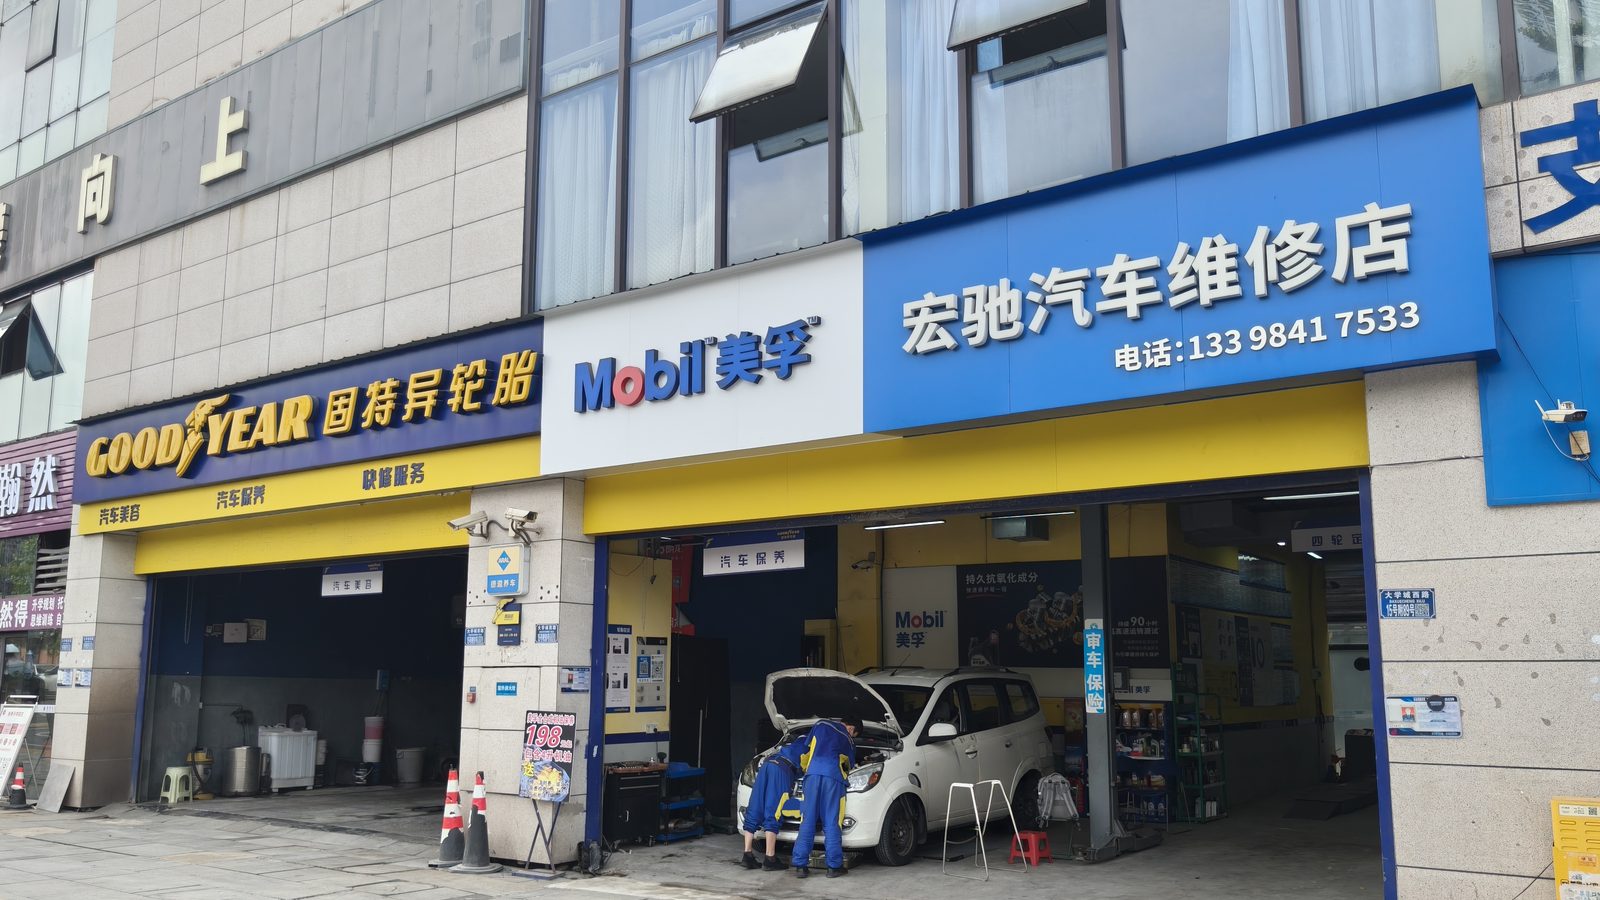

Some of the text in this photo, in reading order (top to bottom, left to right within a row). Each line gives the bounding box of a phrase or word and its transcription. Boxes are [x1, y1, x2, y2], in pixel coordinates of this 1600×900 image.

[902, 202, 1413, 356] 宏驰汽车维修店
[716, 318, 813, 391] 美孚
[574, 339, 706, 414] Mobil
[323, 349, 536, 437] 固特异轮胎
[362, 462, 425, 491] 快修服务
[216, 484, 266, 510] 汽车保养
[99, 504, 141, 526] 汽车美容
[720, 550, 785, 569] 汽车保养
[965, 572, 1039, 585] 持久抗氧化成分
[1385, 591, 1430, 599] 大学城西路
[895, 611, 944, 629] Mobil
[896, 632, 925, 648] 美孚
[1085, 633, 1104, 712] 审车保险
[526, 725, 563, 748] 198
